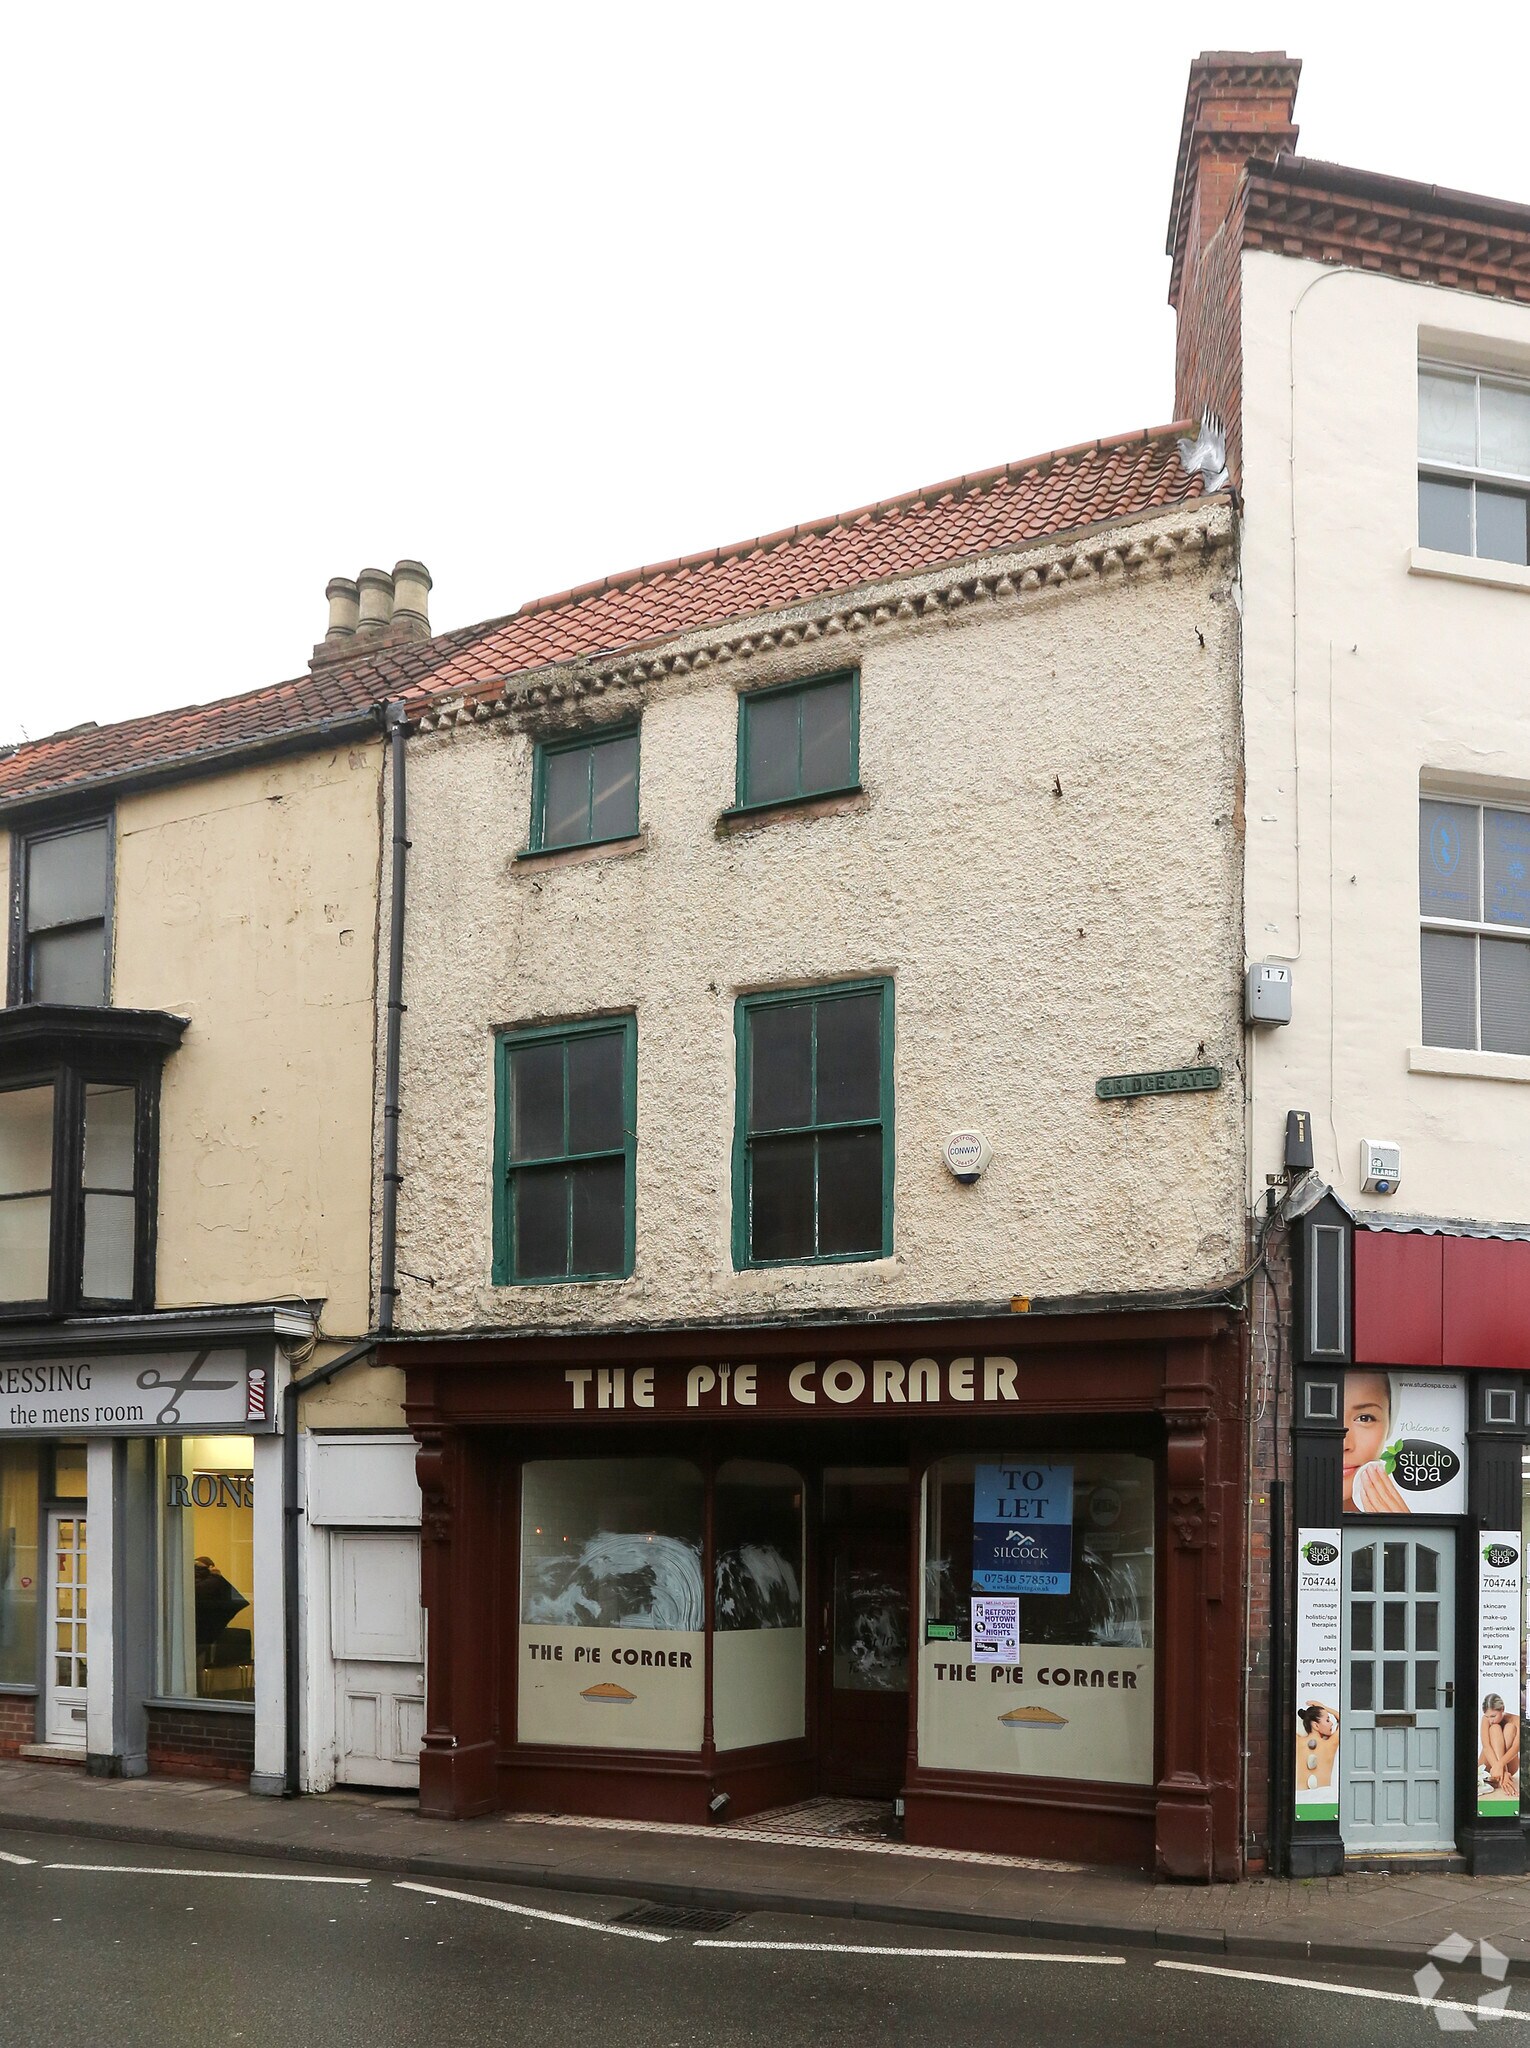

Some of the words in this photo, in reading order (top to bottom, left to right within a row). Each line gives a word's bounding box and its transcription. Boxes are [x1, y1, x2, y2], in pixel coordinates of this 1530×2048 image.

[1265, 969, 1285, 980] 17
[1101, 1071, 1214, 1095] BRIDGEGATE
[950, 1146, 979, 1156] CONWAY
[1372, 1168, 1398, 1177] ALARMS
[565, 1367, 655, 1409] THE
[687, 1363, 757, 1407] PIE
[789, 1356, 1020, 1404] CORNER
[10, 1405, 37, 1424] the
[42, 1407, 90, 1423] mens
[95, 1405, 143, 1421] room
[1401, 1422, 1439, 1432] Welcome
[1399, 1451, 1452, 1467] studio
[1003, 1470, 1044, 1491] TO
[1403, 1466, 1441, 1485] spa
[996, 1498, 1049, 1519] LET
[993, 1547, 1048, 1559] SILCOCK
[1311, 1554, 1330, 1563] spa
[1490, 1549, 1515, 1557] studio
[1492, 1556, 1510, 1566] spa
[984, 1574, 1016, 1584] 07540
[1018, 1575, 1058, 1586] 578530
[1302, 1577, 1336, 1586] 704744
[1483, 1579, 1516, 1587] 704744
[529, 1644, 563, 1661] THE
[574, 1646, 600, 1663] PIE
[611, 1649, 692, 1668] CORNER
[934, 1664, 977, 1682] THE
[991, 1666, 1024, 1684] PIE
[1037, 1667, 1137, 1689] CORNER
